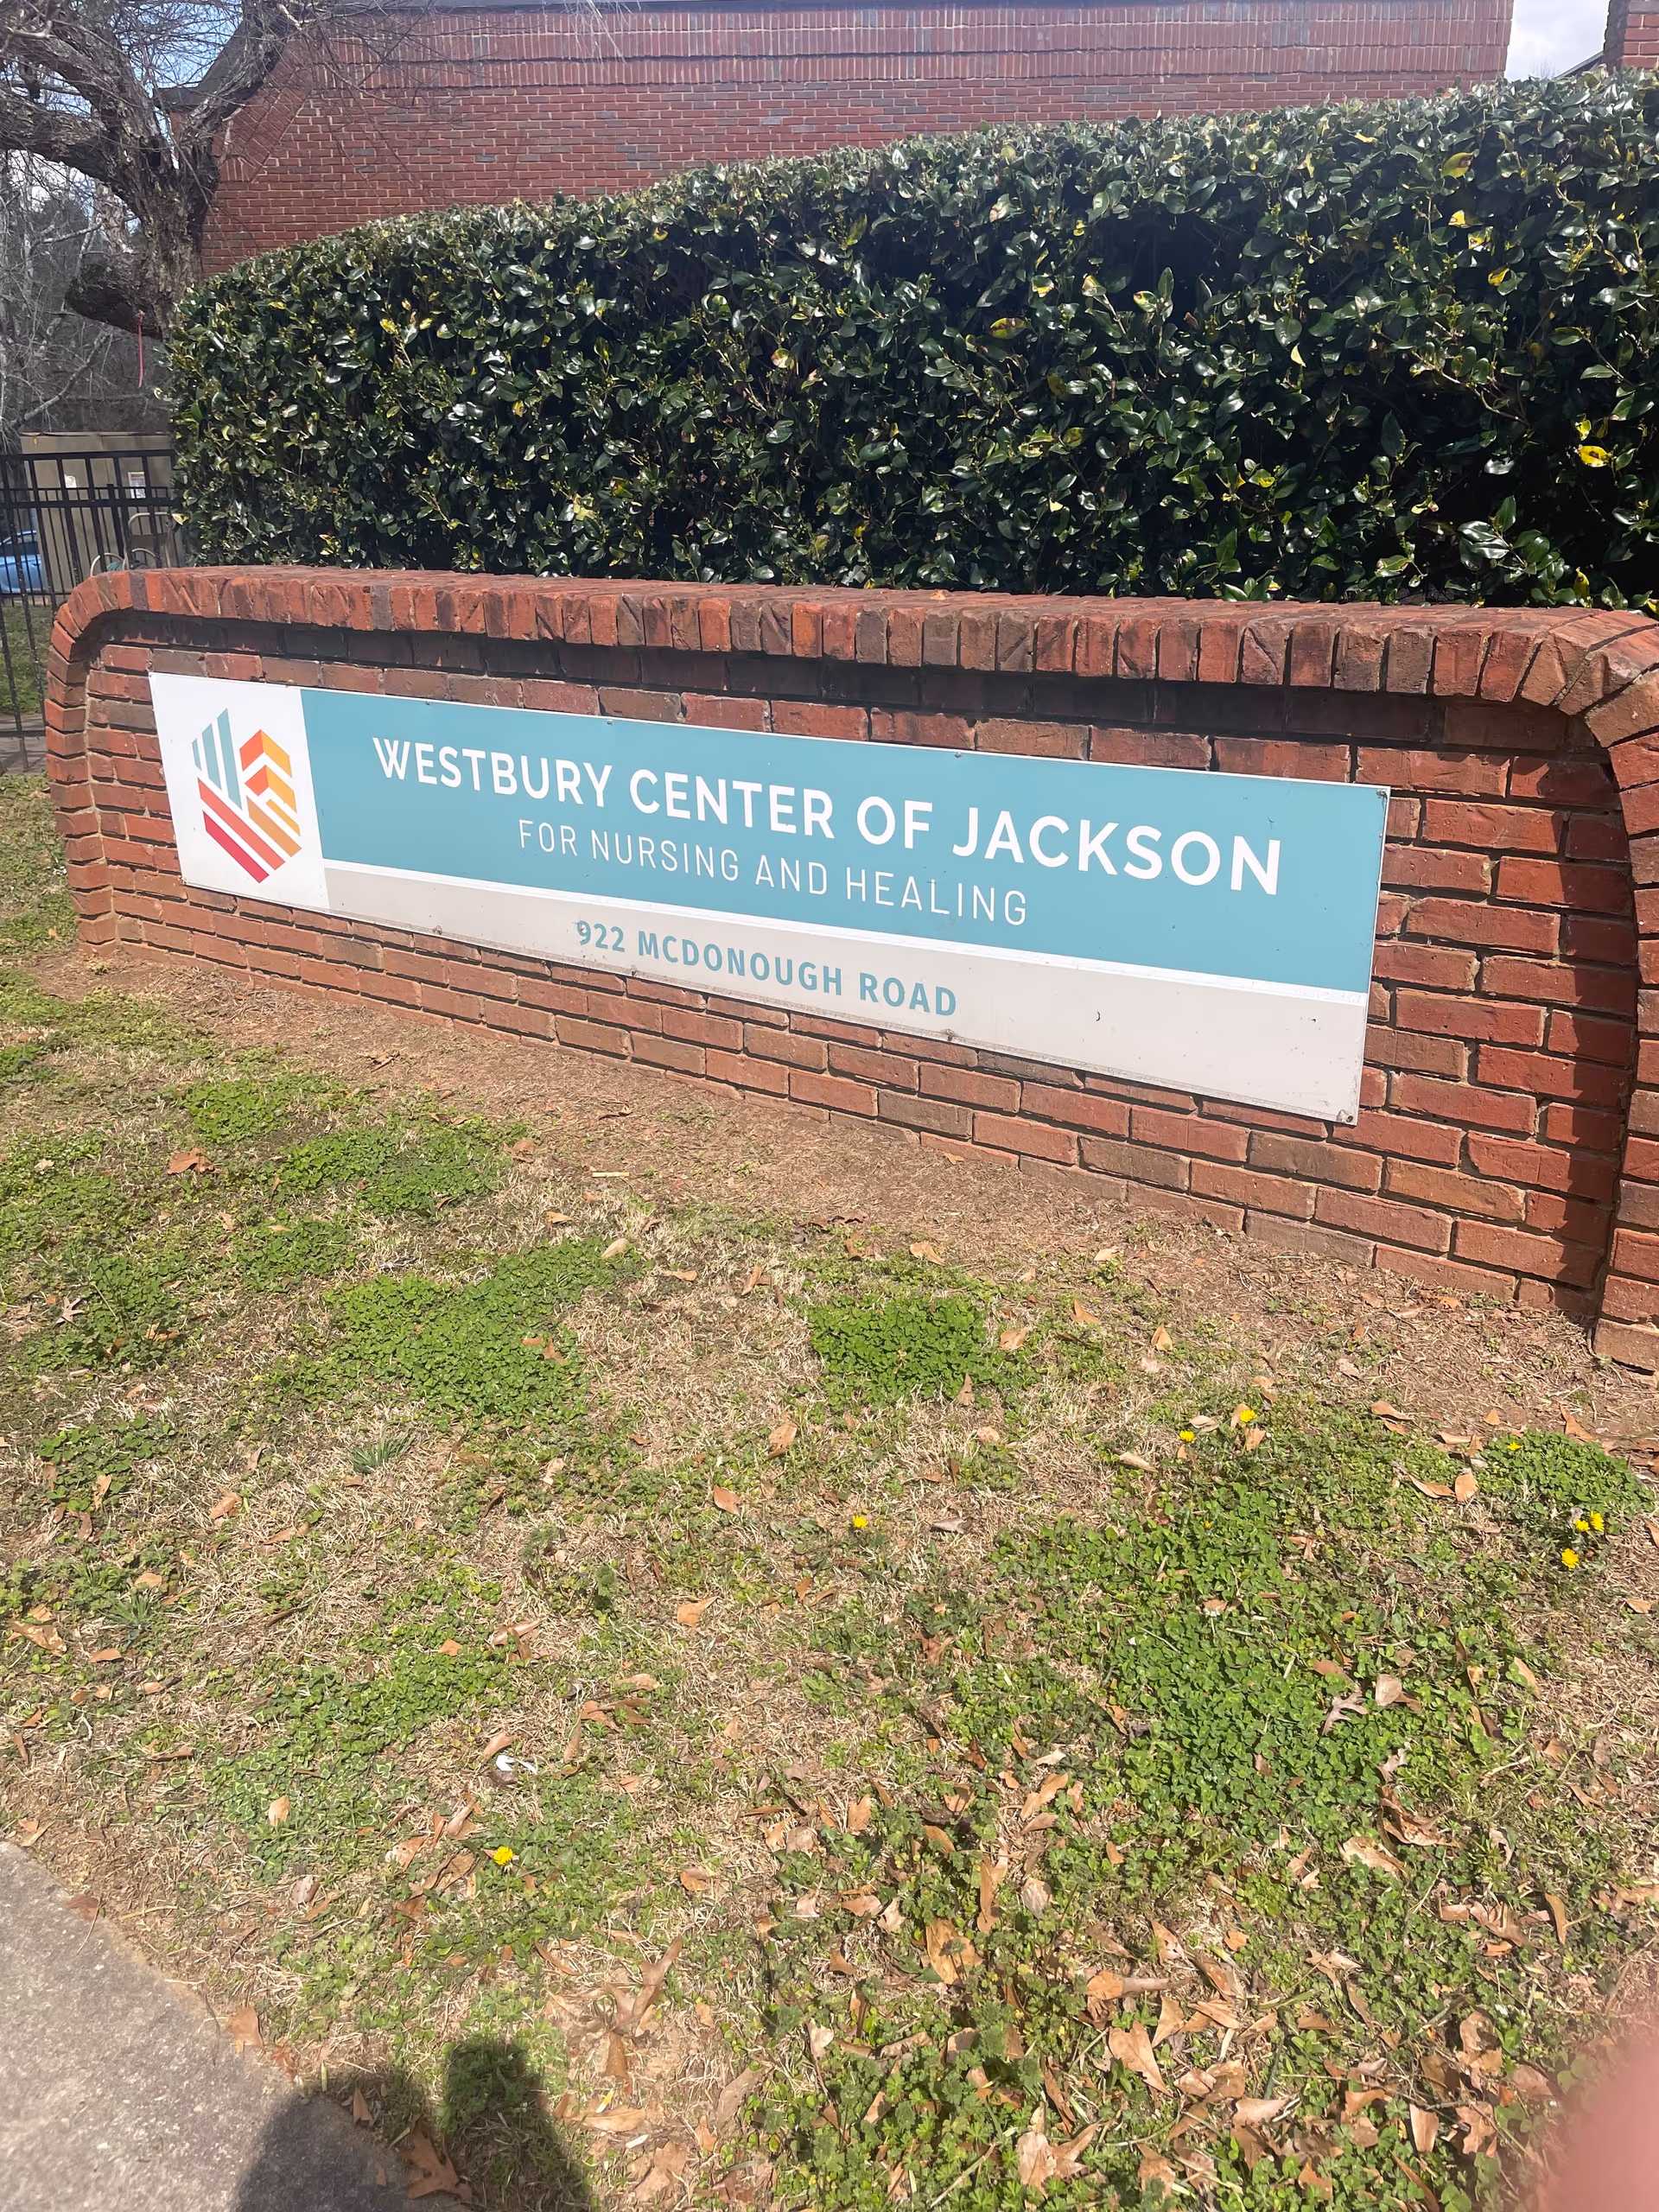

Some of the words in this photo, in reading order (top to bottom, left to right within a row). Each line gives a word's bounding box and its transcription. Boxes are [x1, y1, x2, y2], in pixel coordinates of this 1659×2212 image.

[372, 737, 613, 807] WESTBURY
[629, 767, 836, 839] CENTER
[856, 796, 933, 849] OF
[952, 806, 1281, 895] JACKSON
[518, 817, 578, 855] FOR
[591, 830, 740, 881] NURSING
[754, 854, 827, 894] AND
[846, 866, 1027, 926] HEALING
[576, 920, 626, 953] 922
[638, 930, 842, 996] MCDONOUGH
[859, 972, 957, 1017] ROAD
